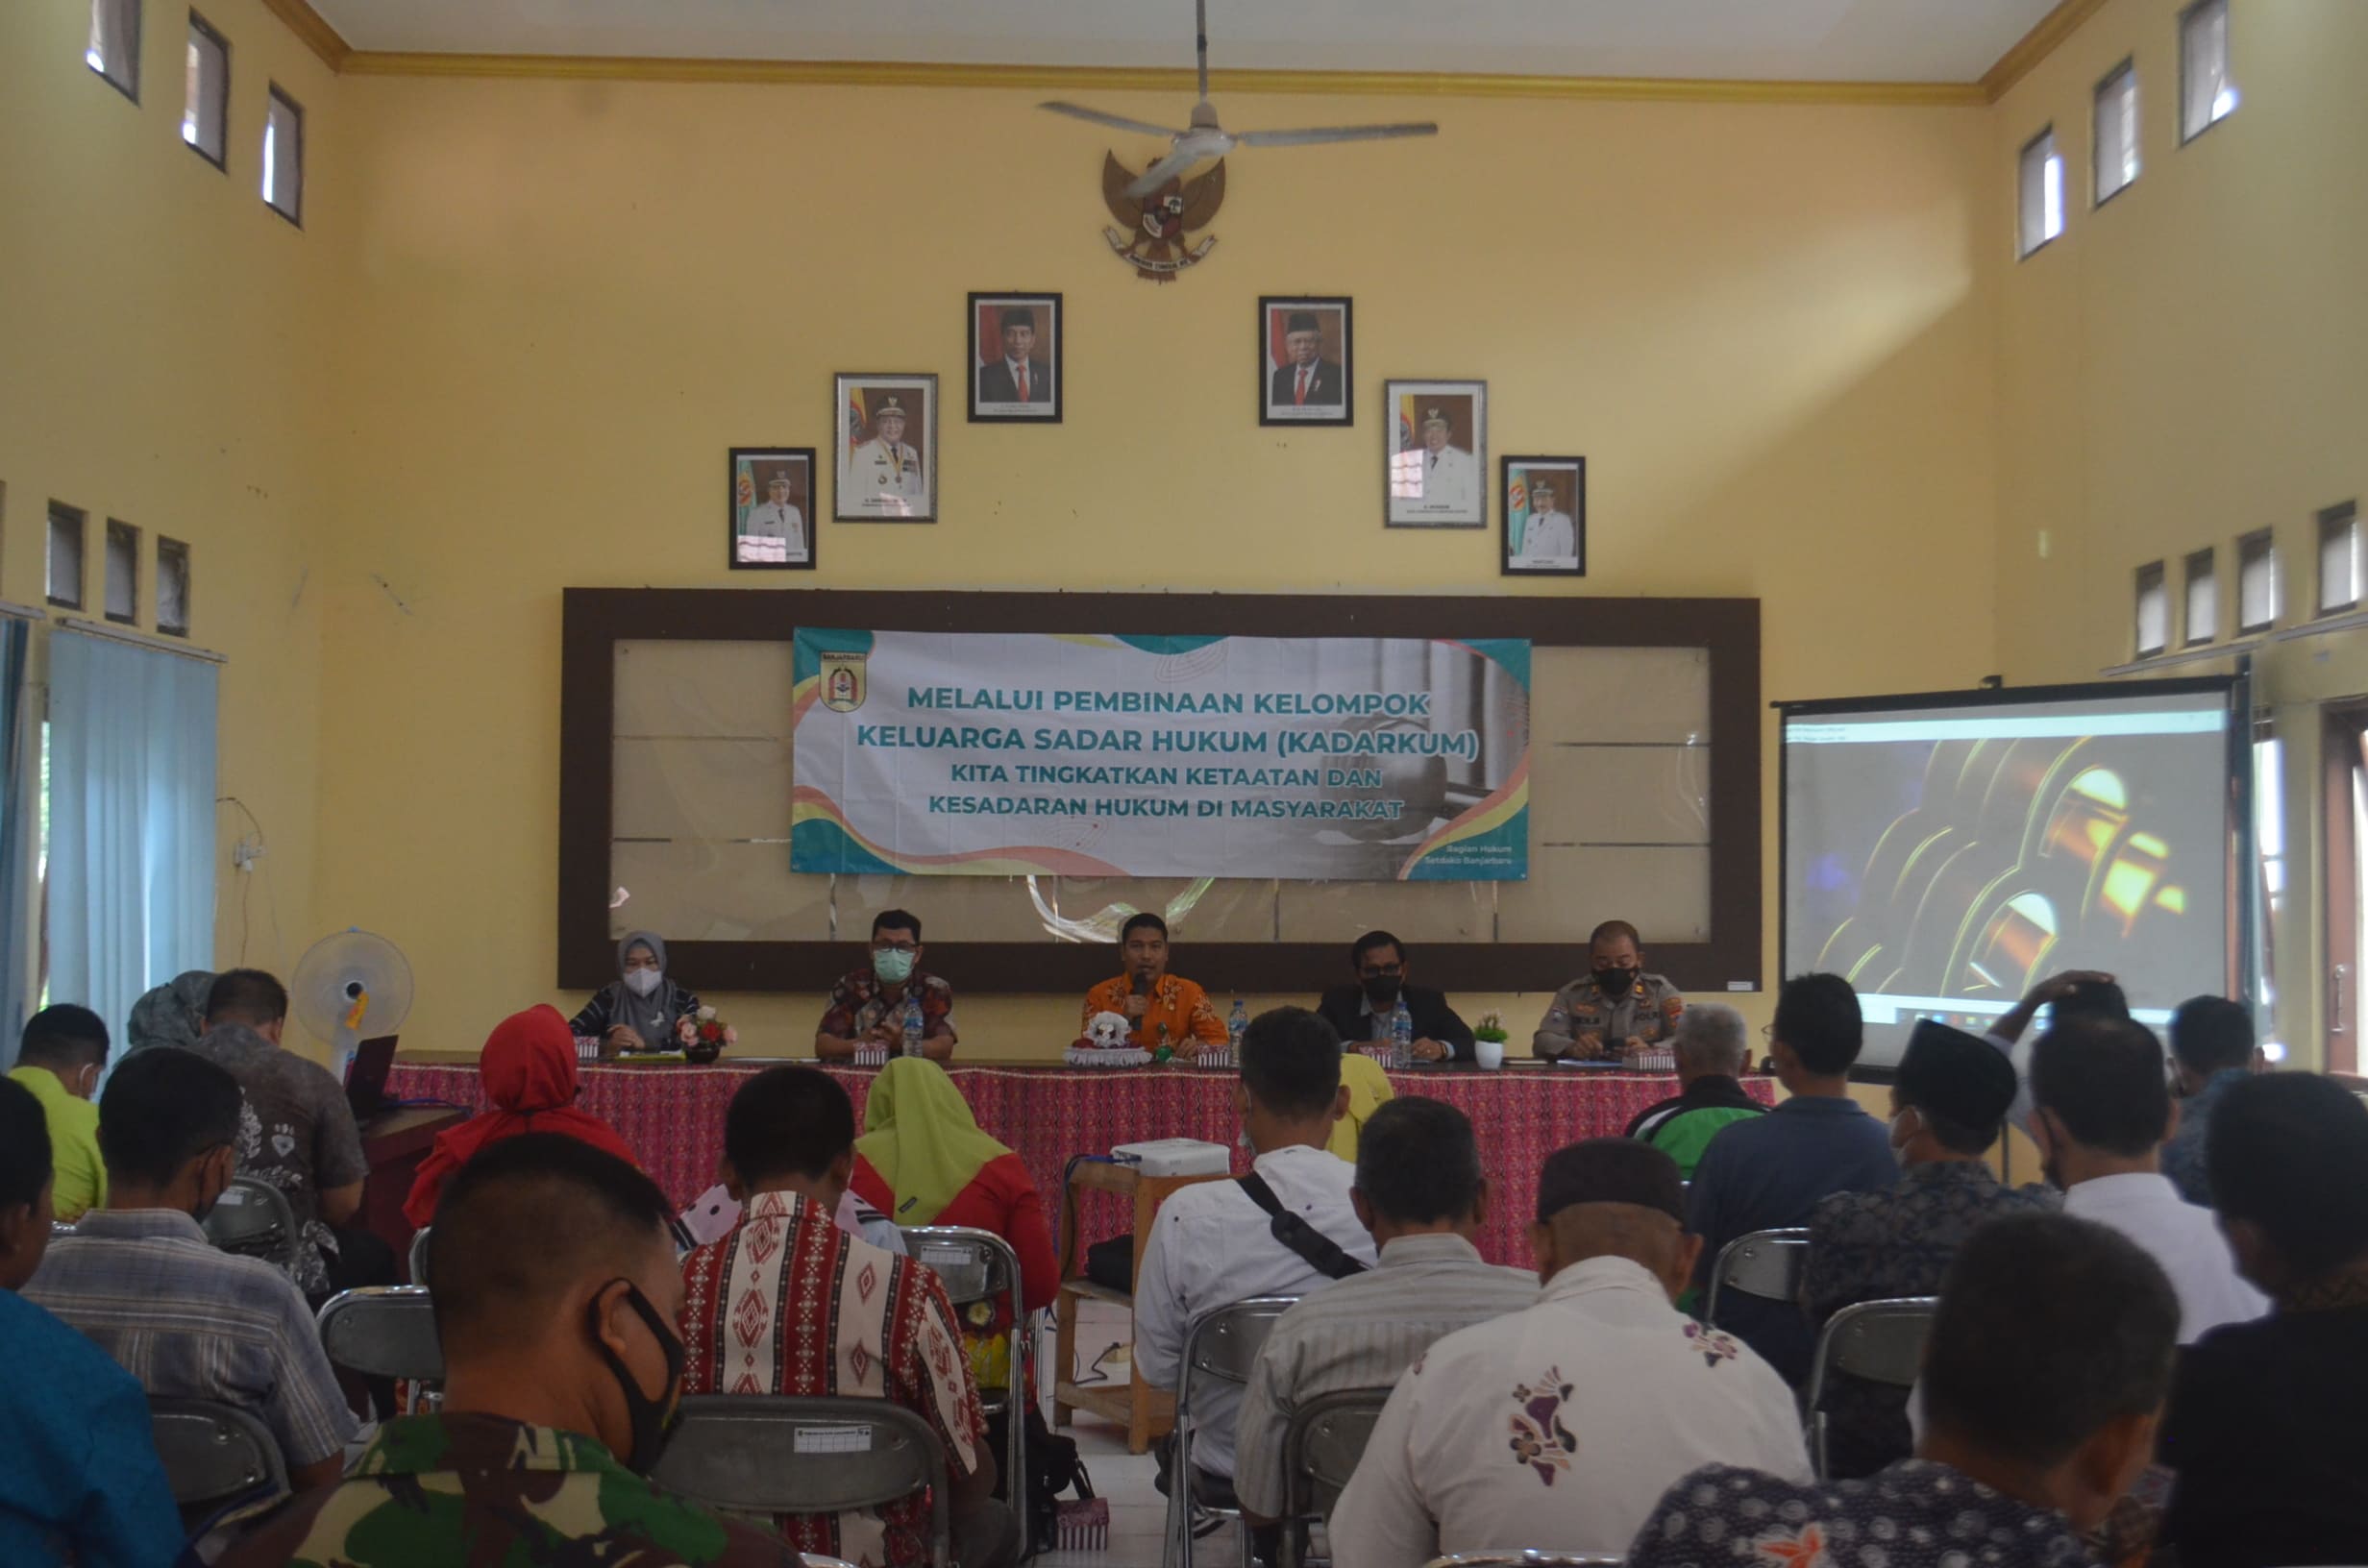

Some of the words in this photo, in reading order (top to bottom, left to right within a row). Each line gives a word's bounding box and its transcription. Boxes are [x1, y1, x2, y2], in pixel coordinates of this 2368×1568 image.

[907, 687, 1043, 711] MELALUI
[1053, 691, 1244, 714] PEMBINAAN
[1253, 694, 1429, 715] KELOMPOK
[857, 724, 1026, 750] KELUARGA
[1034, 727, 1143, 752] SADAR
[1152, 729, 1268, 753] HUKUM
[1277, 730, 1477, 760] (KADARKUM)
[950, 764, 1008, 783] KITA
[1015, 765, 1178, 786] TINGKATKAN
[1185, 768, 1320, 787] KETAATAN
[1326, 770, 1382, 788] DAN
[928, 795, 1087, 817] KESADARAN
[1094, 798, 1190, 817] HUKUM
[1196, 799, 1223, 818] DI
[1230, 799, 1404, 820] MASYARAKAT
